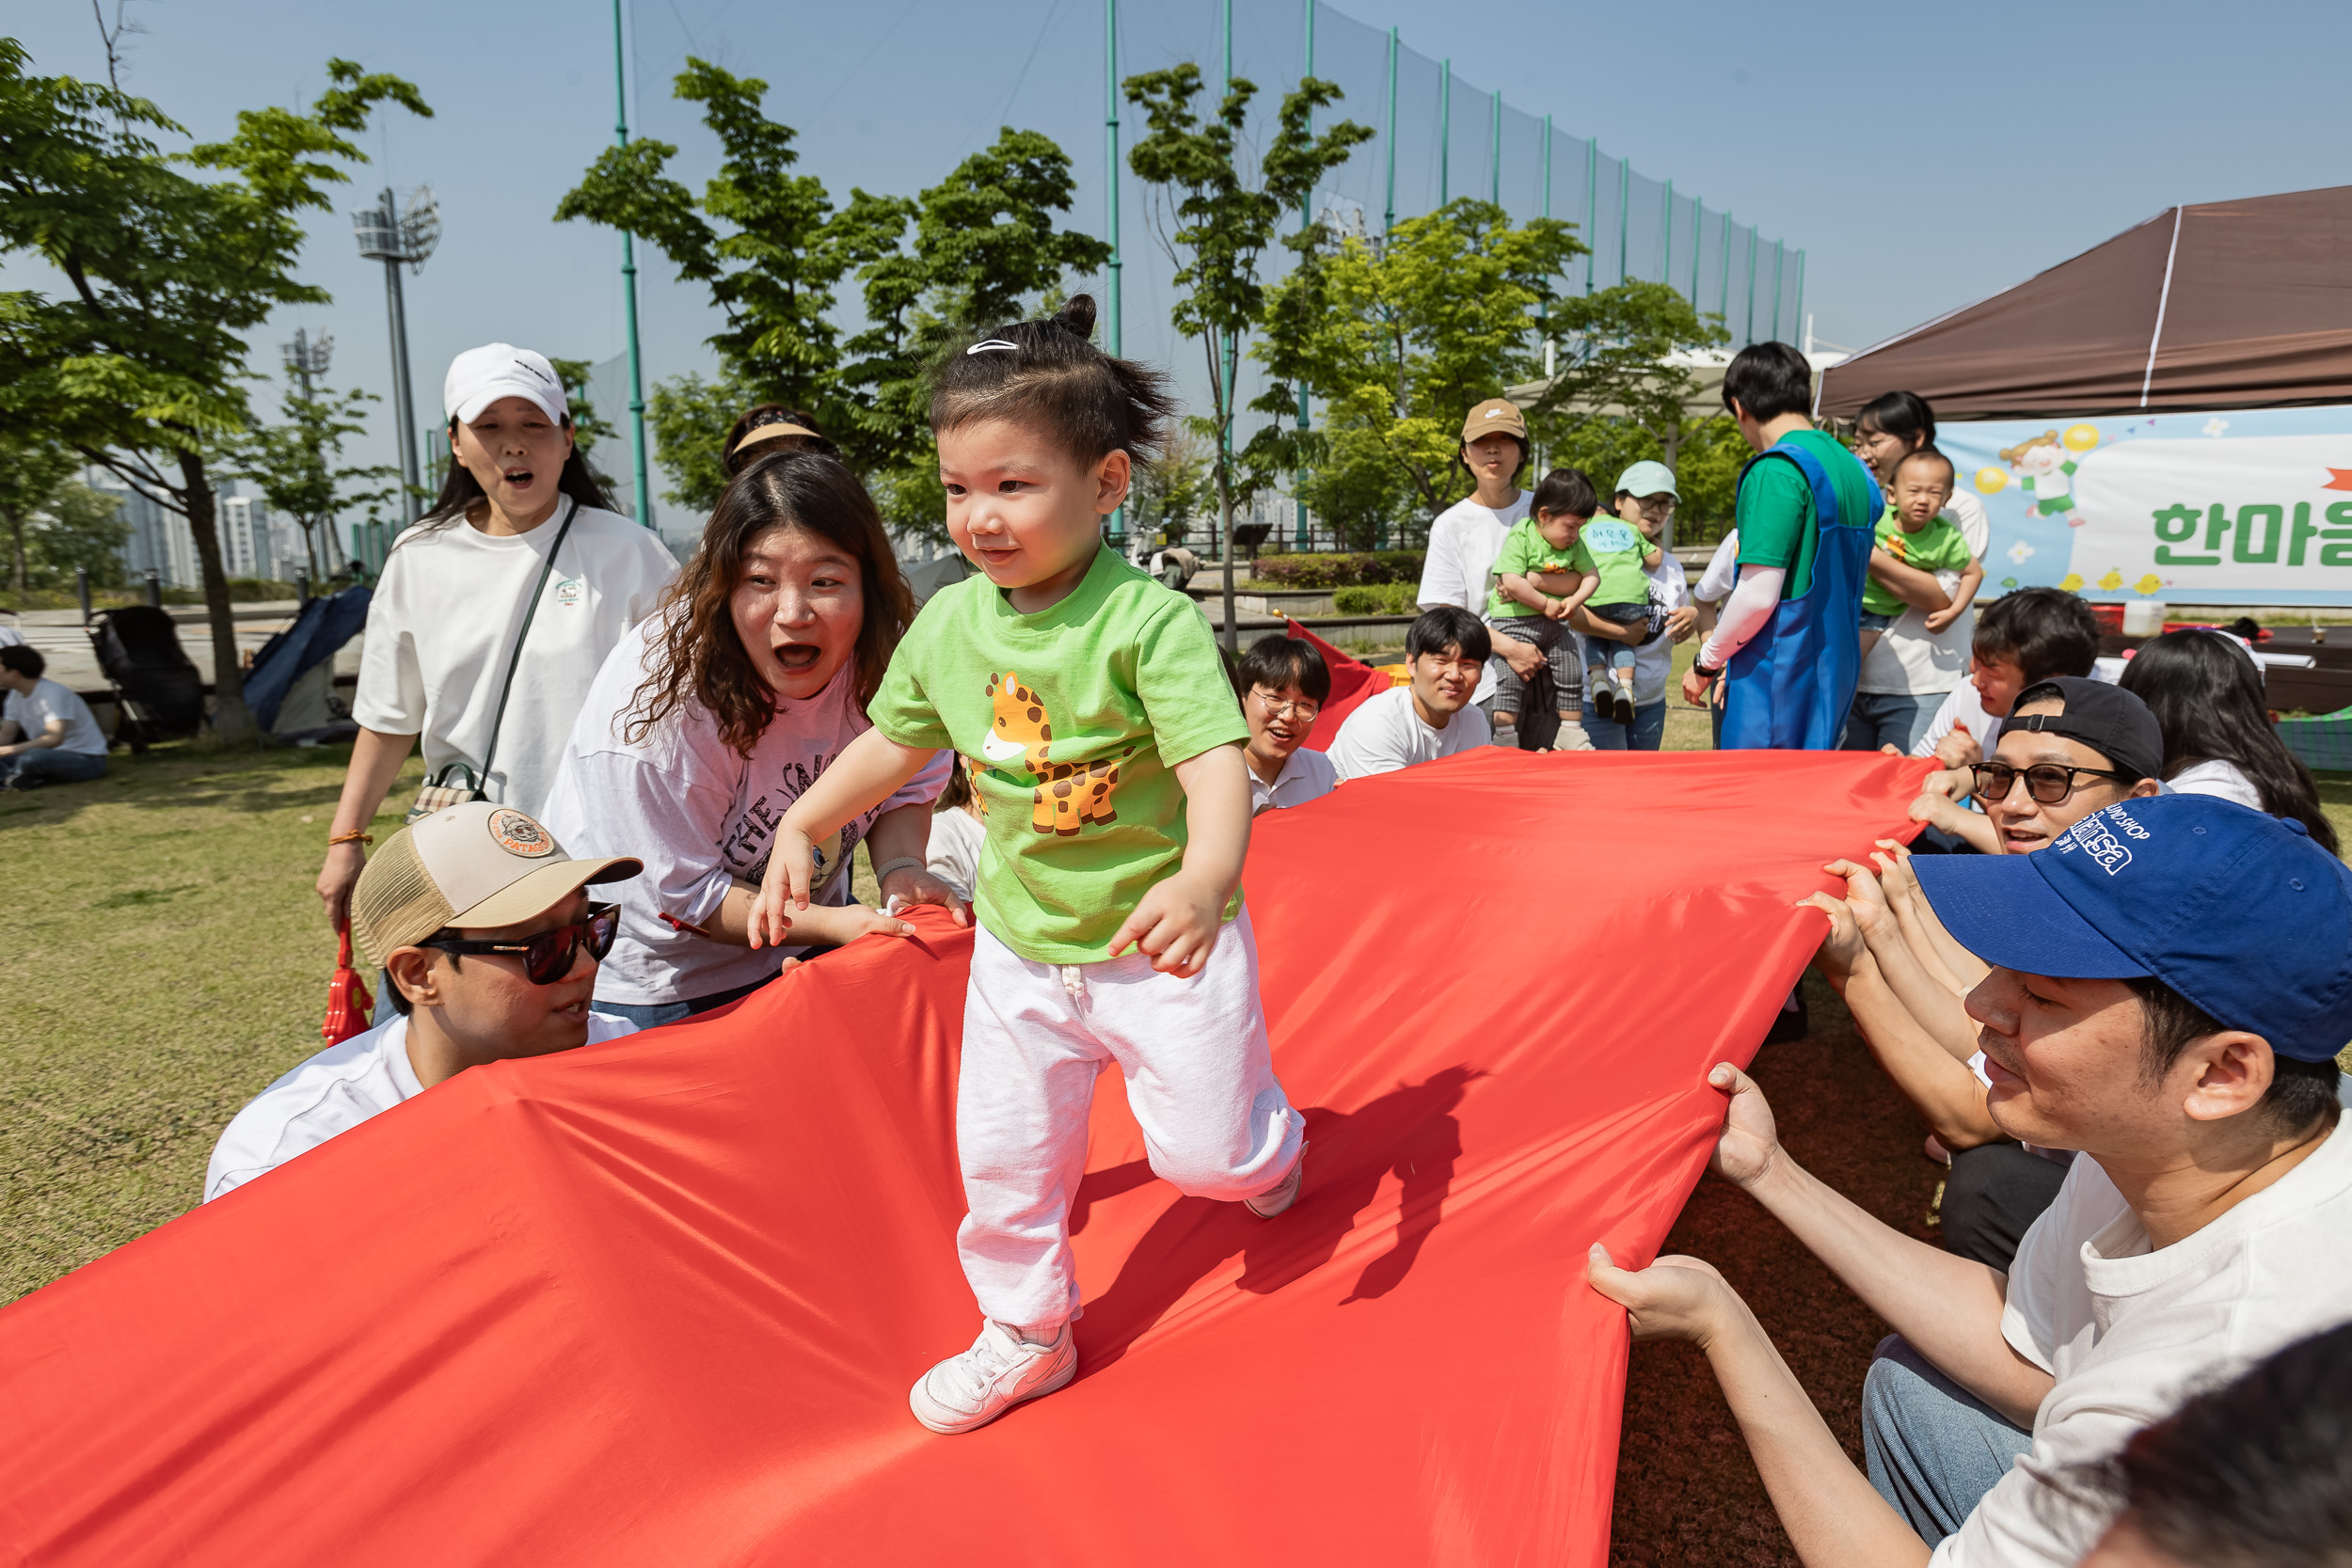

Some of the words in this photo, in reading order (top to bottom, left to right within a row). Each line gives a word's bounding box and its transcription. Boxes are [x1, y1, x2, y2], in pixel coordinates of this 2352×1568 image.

[2105, 801, 2128, 820] UND
[723, 795, 783, 867] THE
[2115, 817, 2151, 840] SHOP
